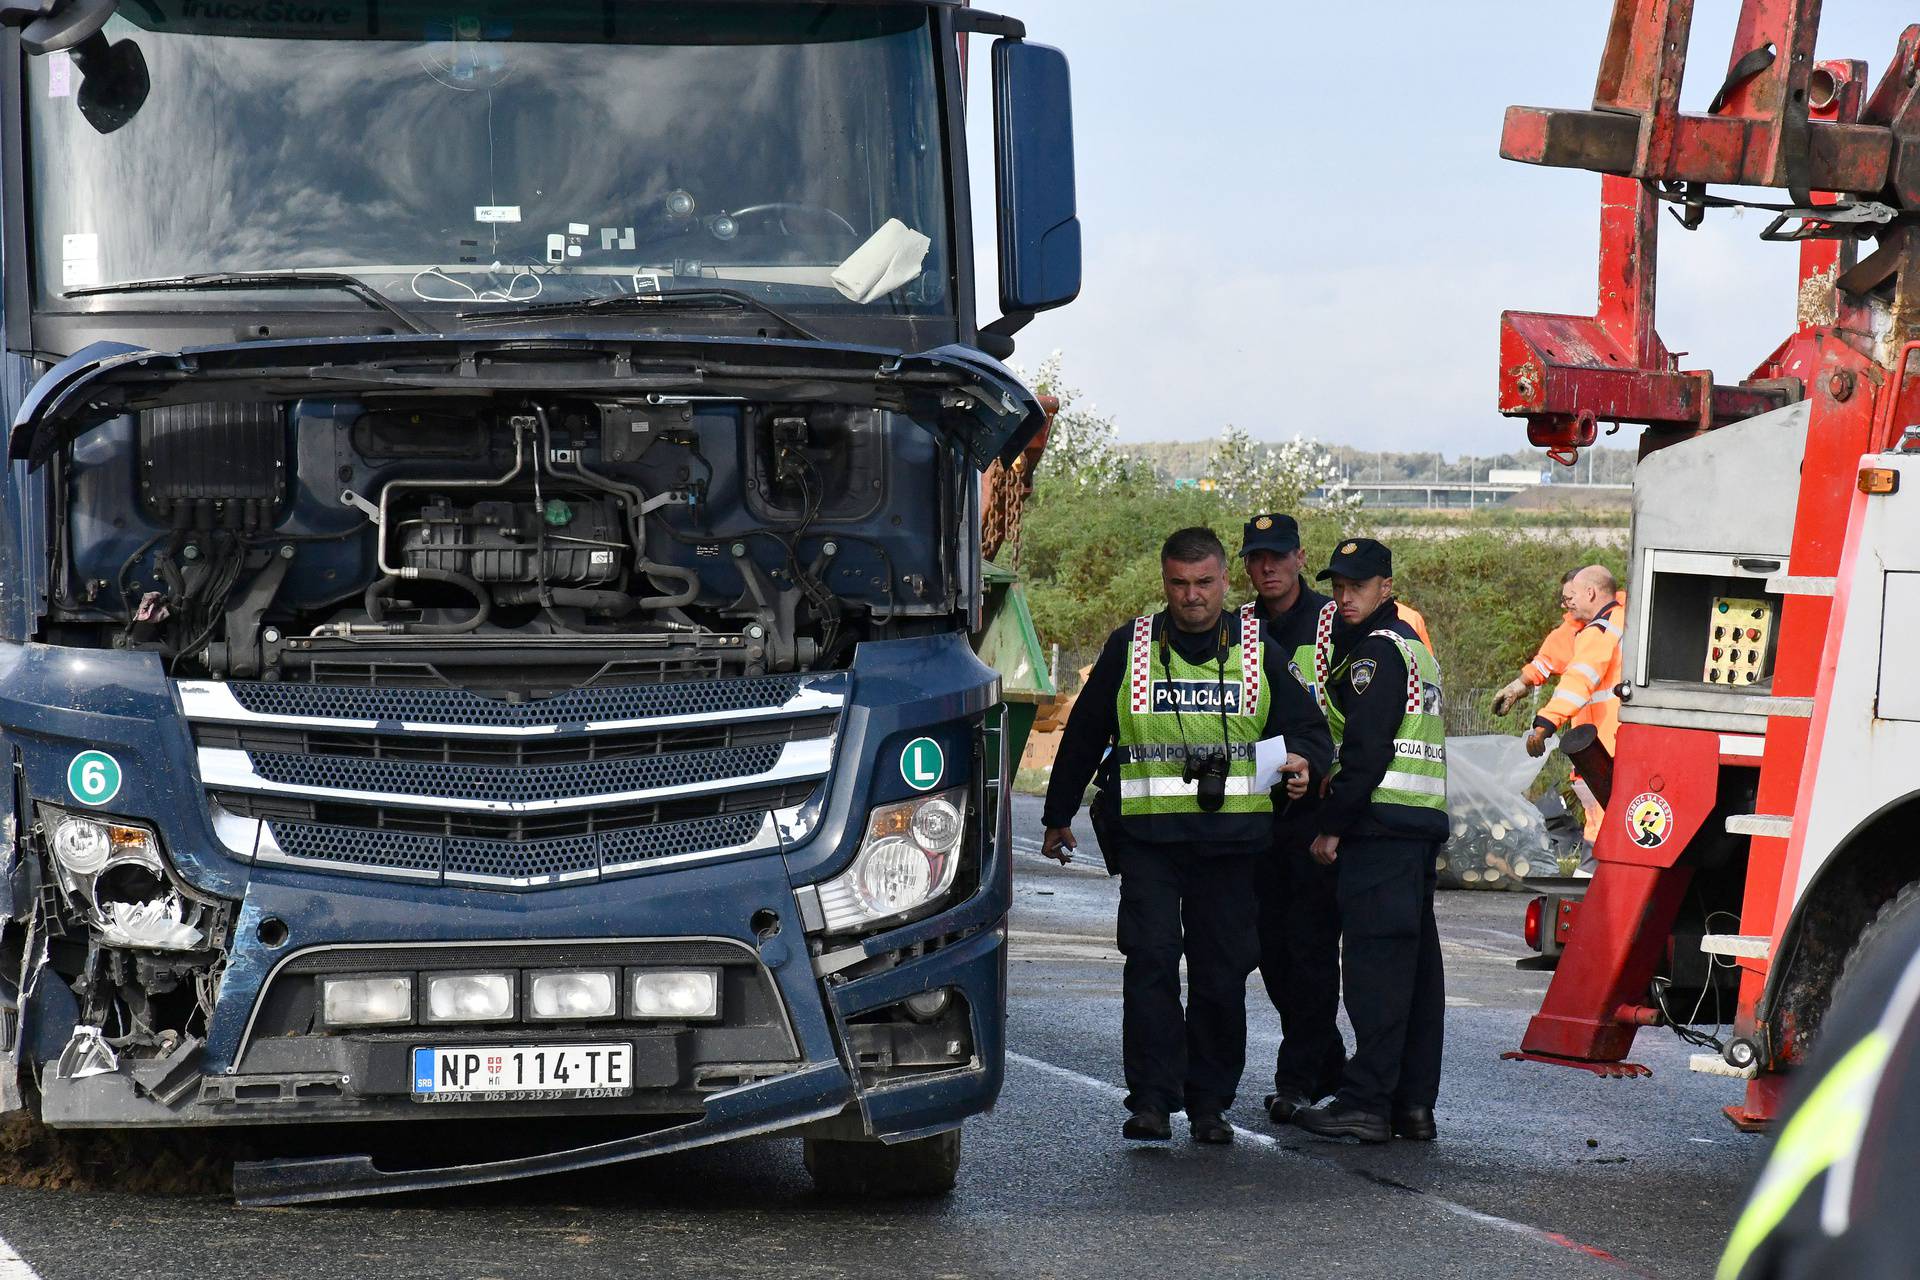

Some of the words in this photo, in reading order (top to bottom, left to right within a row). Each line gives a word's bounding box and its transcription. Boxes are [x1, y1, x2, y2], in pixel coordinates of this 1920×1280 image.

[1156, 689, 1236, 706] POLICIJA
[915, 747, 934, 780] L
[82, 760, 105, 795] 6
[441, 1054, 480, 1086] NP
[417, 1078, 433, 1087] SRB
[484, 1091, 507, 1101] 063
[510, 1090, 526, 1101] 39
[529, 1089, 544, 1100] 39
[547, 1089, 562, 1100] 39
